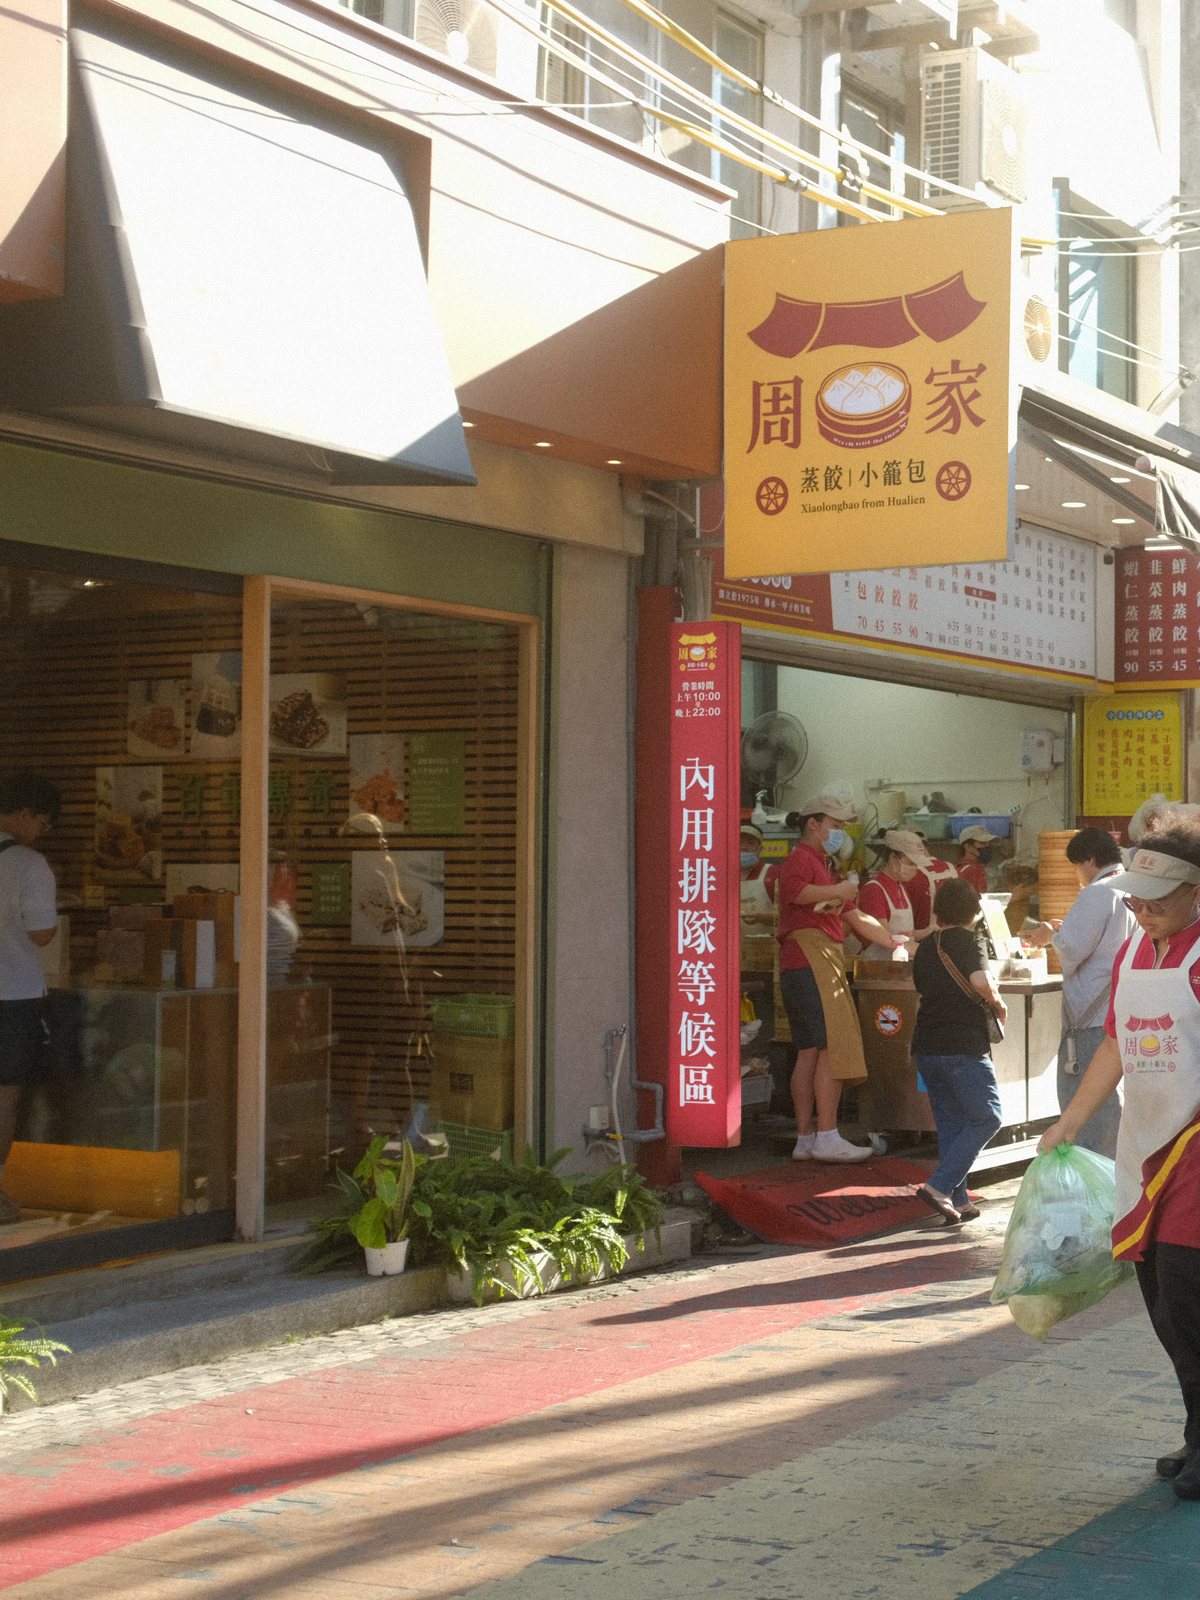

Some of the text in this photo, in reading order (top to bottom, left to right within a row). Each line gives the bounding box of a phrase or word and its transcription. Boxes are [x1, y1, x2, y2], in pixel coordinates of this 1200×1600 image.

[746, 359, 988, 453] 周 家
[800, 458, 927, 494] 蒸餃 小籠包
[801, 494, 926, 514] Xiaolongbao from Hualien
[1172, 558, 1187, 642] 鮮肉蒸餃
[858, 616, 867, 629] 70
[874, 620, 884, 633] 45
[892, 622, 902, 635] 55
[909, 625, 918, 639] 90
[1123, 662, 1139, 673] 90
[1149, 660, 1163, 672] 55
[1172, 660, 1187, 671] 45
[693, 691, 720, 701] 10:00
[692, 707, 721, 717] 22:00
[677, 757, 716, 1107] 內用排隊等候區
[1162, 1035, 1179, 1055] 家
